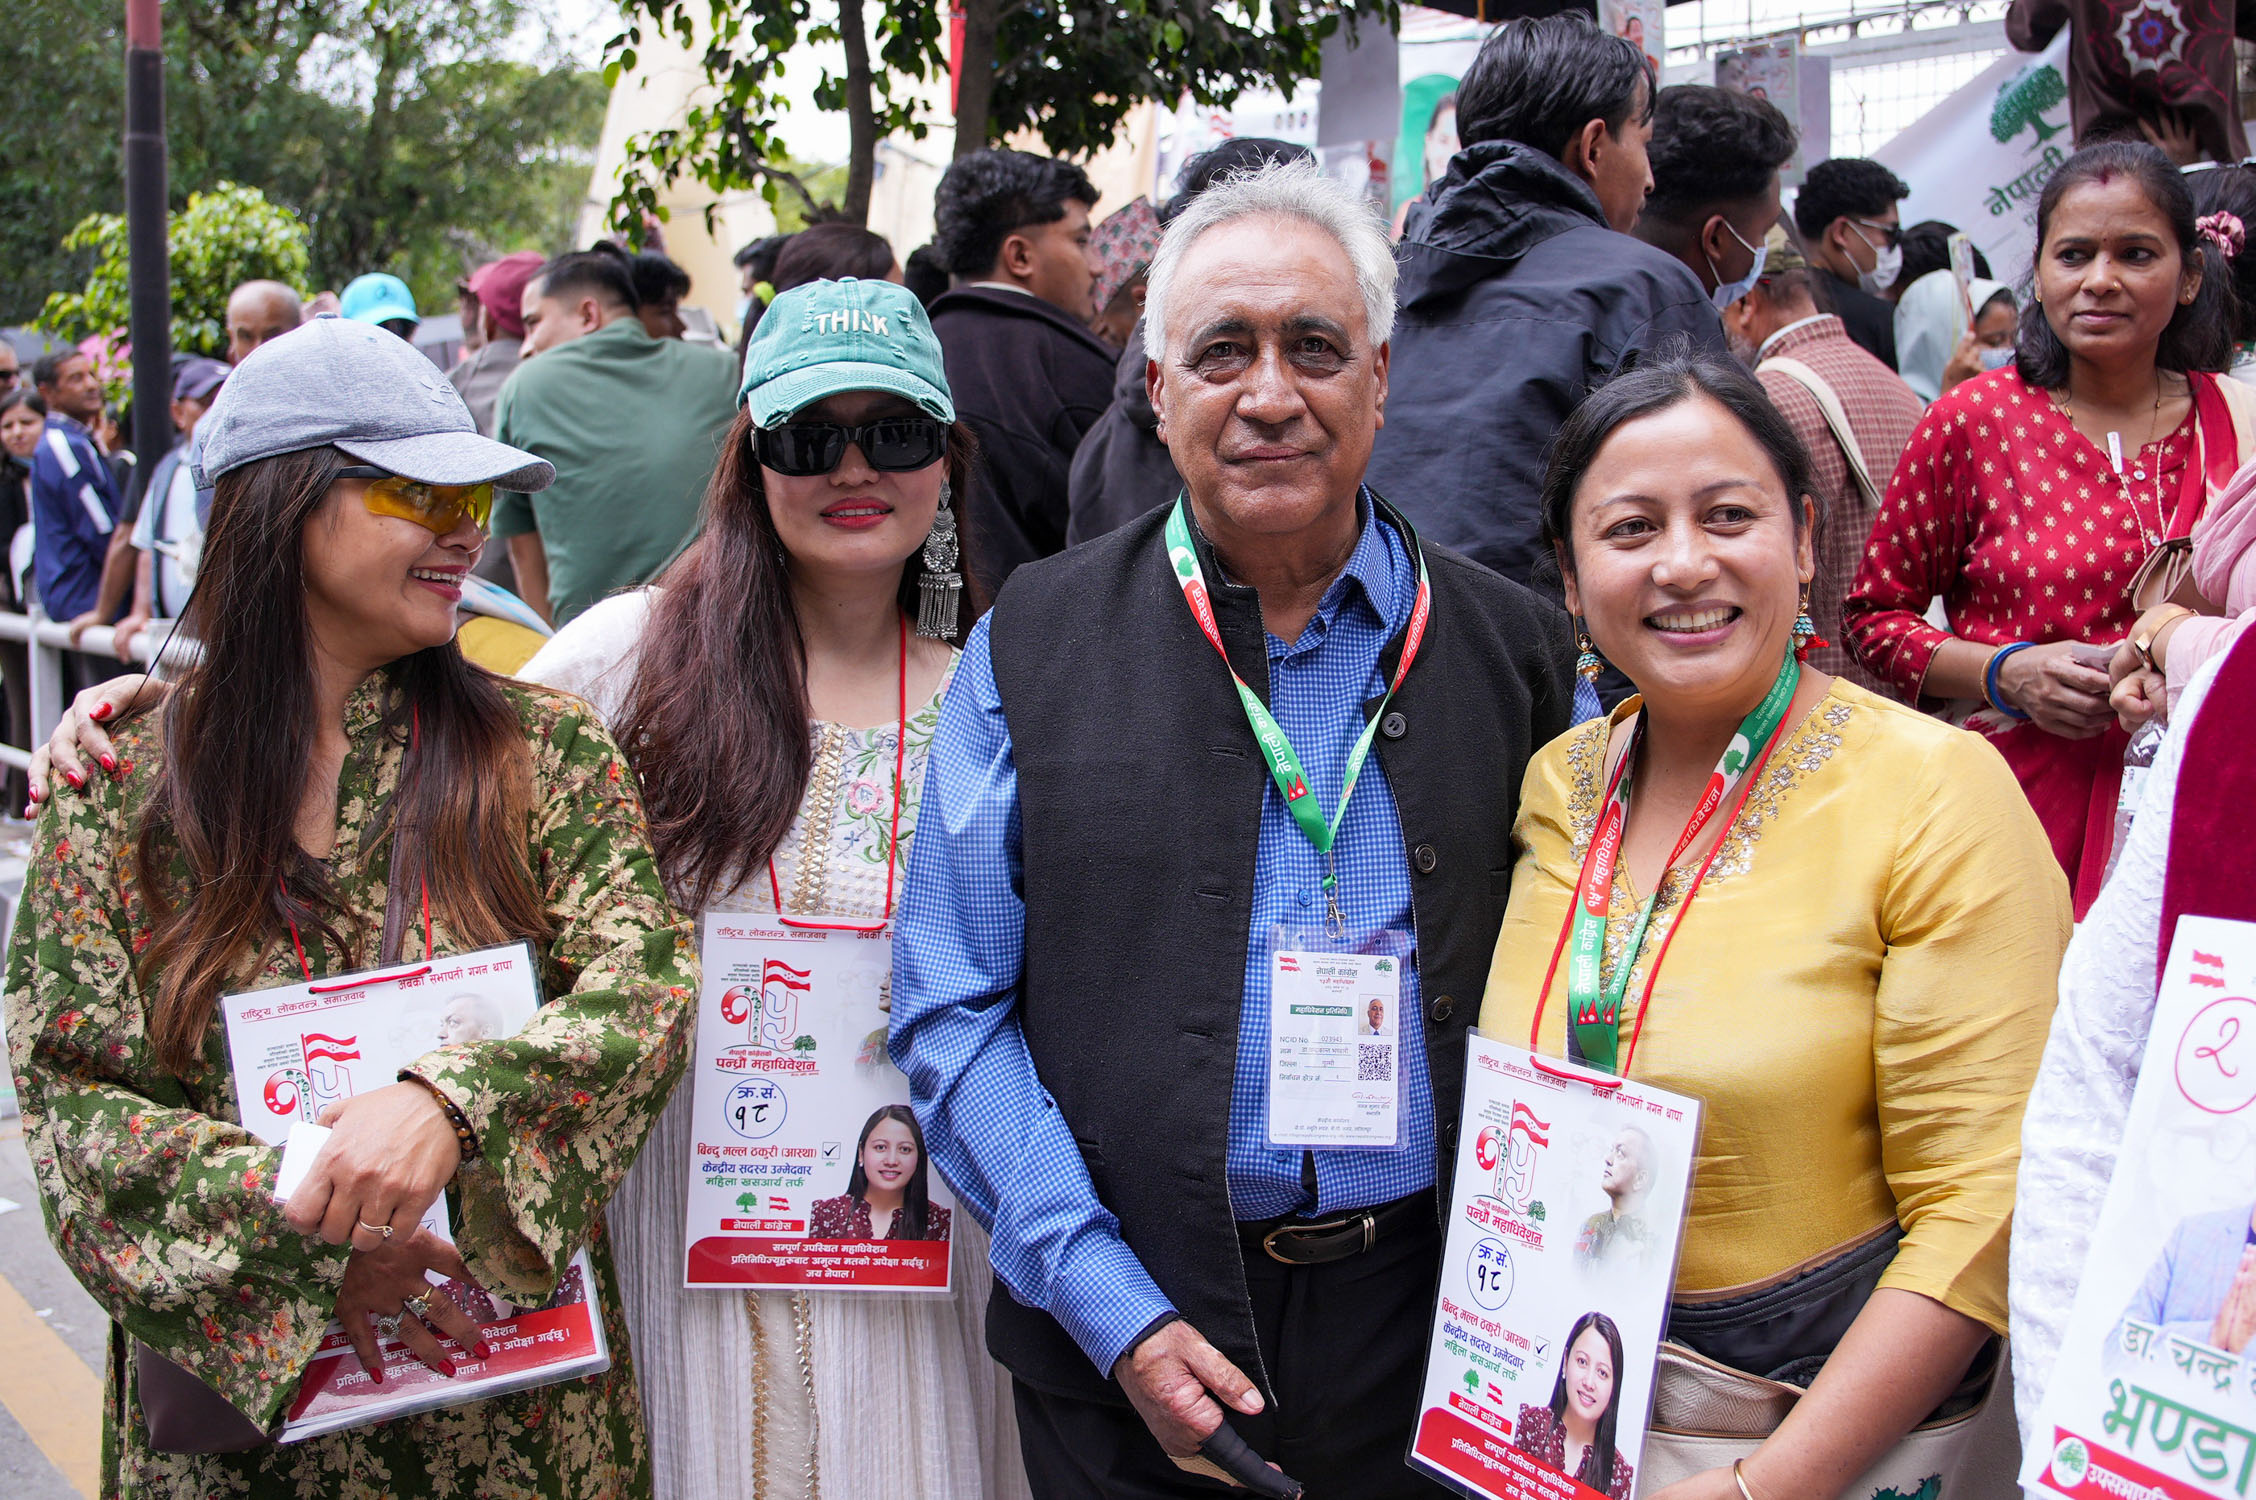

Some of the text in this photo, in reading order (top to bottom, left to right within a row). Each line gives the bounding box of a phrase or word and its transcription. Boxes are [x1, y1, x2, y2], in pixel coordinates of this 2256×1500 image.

[814, 308, 890, 337] THINK
[1262, 732, 1293, 776] नेपाली
[1574, 953, 1593, 995] नेपाली
[1591, 816, 1621, 885] महाधिवेशन
[790, 931, 828, 941] समाजवाद
[323, 990, 367, 1006] समाजवाद
[467, 963, 489, 978] गगन
[492, 959, 514, 973] थापा
[751, 1057, 817, 1073] महाधिवेशन
[1535, 1071, 1568, 1089] समाजवाद
[1646, 1101, 1663, 1117] गगन
[1665, 1107, 1683, 1123] थापा
[735, 1103, 769, 1131] १८
[696, 1142, 817, 1160] बिन्दु मल्ल ठकुरी (आस्था)
[701, 1160, 736, 1175] केन्द्रीय
[738, 1164, 768, 1175] सदस्य
[770, 1162, 813, 1176] उम्मेदवार
[705, 1174, 737, 1188] महिला
[785, 1176, 806, 1188] तर्फ
[732, 1218, 761, 1231] नेपाली
[1491, 1214, 1543, 1246] महाधिवेशन
[772, 1241, 889, 1256] सम्पूर्ण उपस्थित महाधिवेशन
[843, 1254, 871, 1266] मतको
[872, 1255, 899, 1267] अपेक्षा
[805, 1269, 822, 1279] जय
[824, 1267, 849, 1279] नेपाल
[1477, 1264, 1502, 1292] १८
[1441, 1296, 1459, 1320] बिन्दु
[1459, 1308, 1480, 1327] मल्ल
[1479, 1318, 1502, 1338] ठकुरी
[503, 1334, 535, 1351] अपेक्षा
[1443, 1319, 1526, 1372] केन्द्रीय सदस्य उम्मेदवार
[2126, 1321, 2155, 1361] डा.
[2170, 1337, 2239, 1391] चन्द्र
[1443, 1338, 1468, 1358] महिला
[1501, 1366, 1518, 1382] तर्फ
[1457, 1396, 1480, 1417] नेपाली
[1484, 1438, 1507, 1458] सम्पूर्ण
[1506, 1450, 1537, 1474] उपस्थित
[1537, 1465, 1577, 1496] महाधिवेशन
[1505, 1481, 1520, 1498] जय
